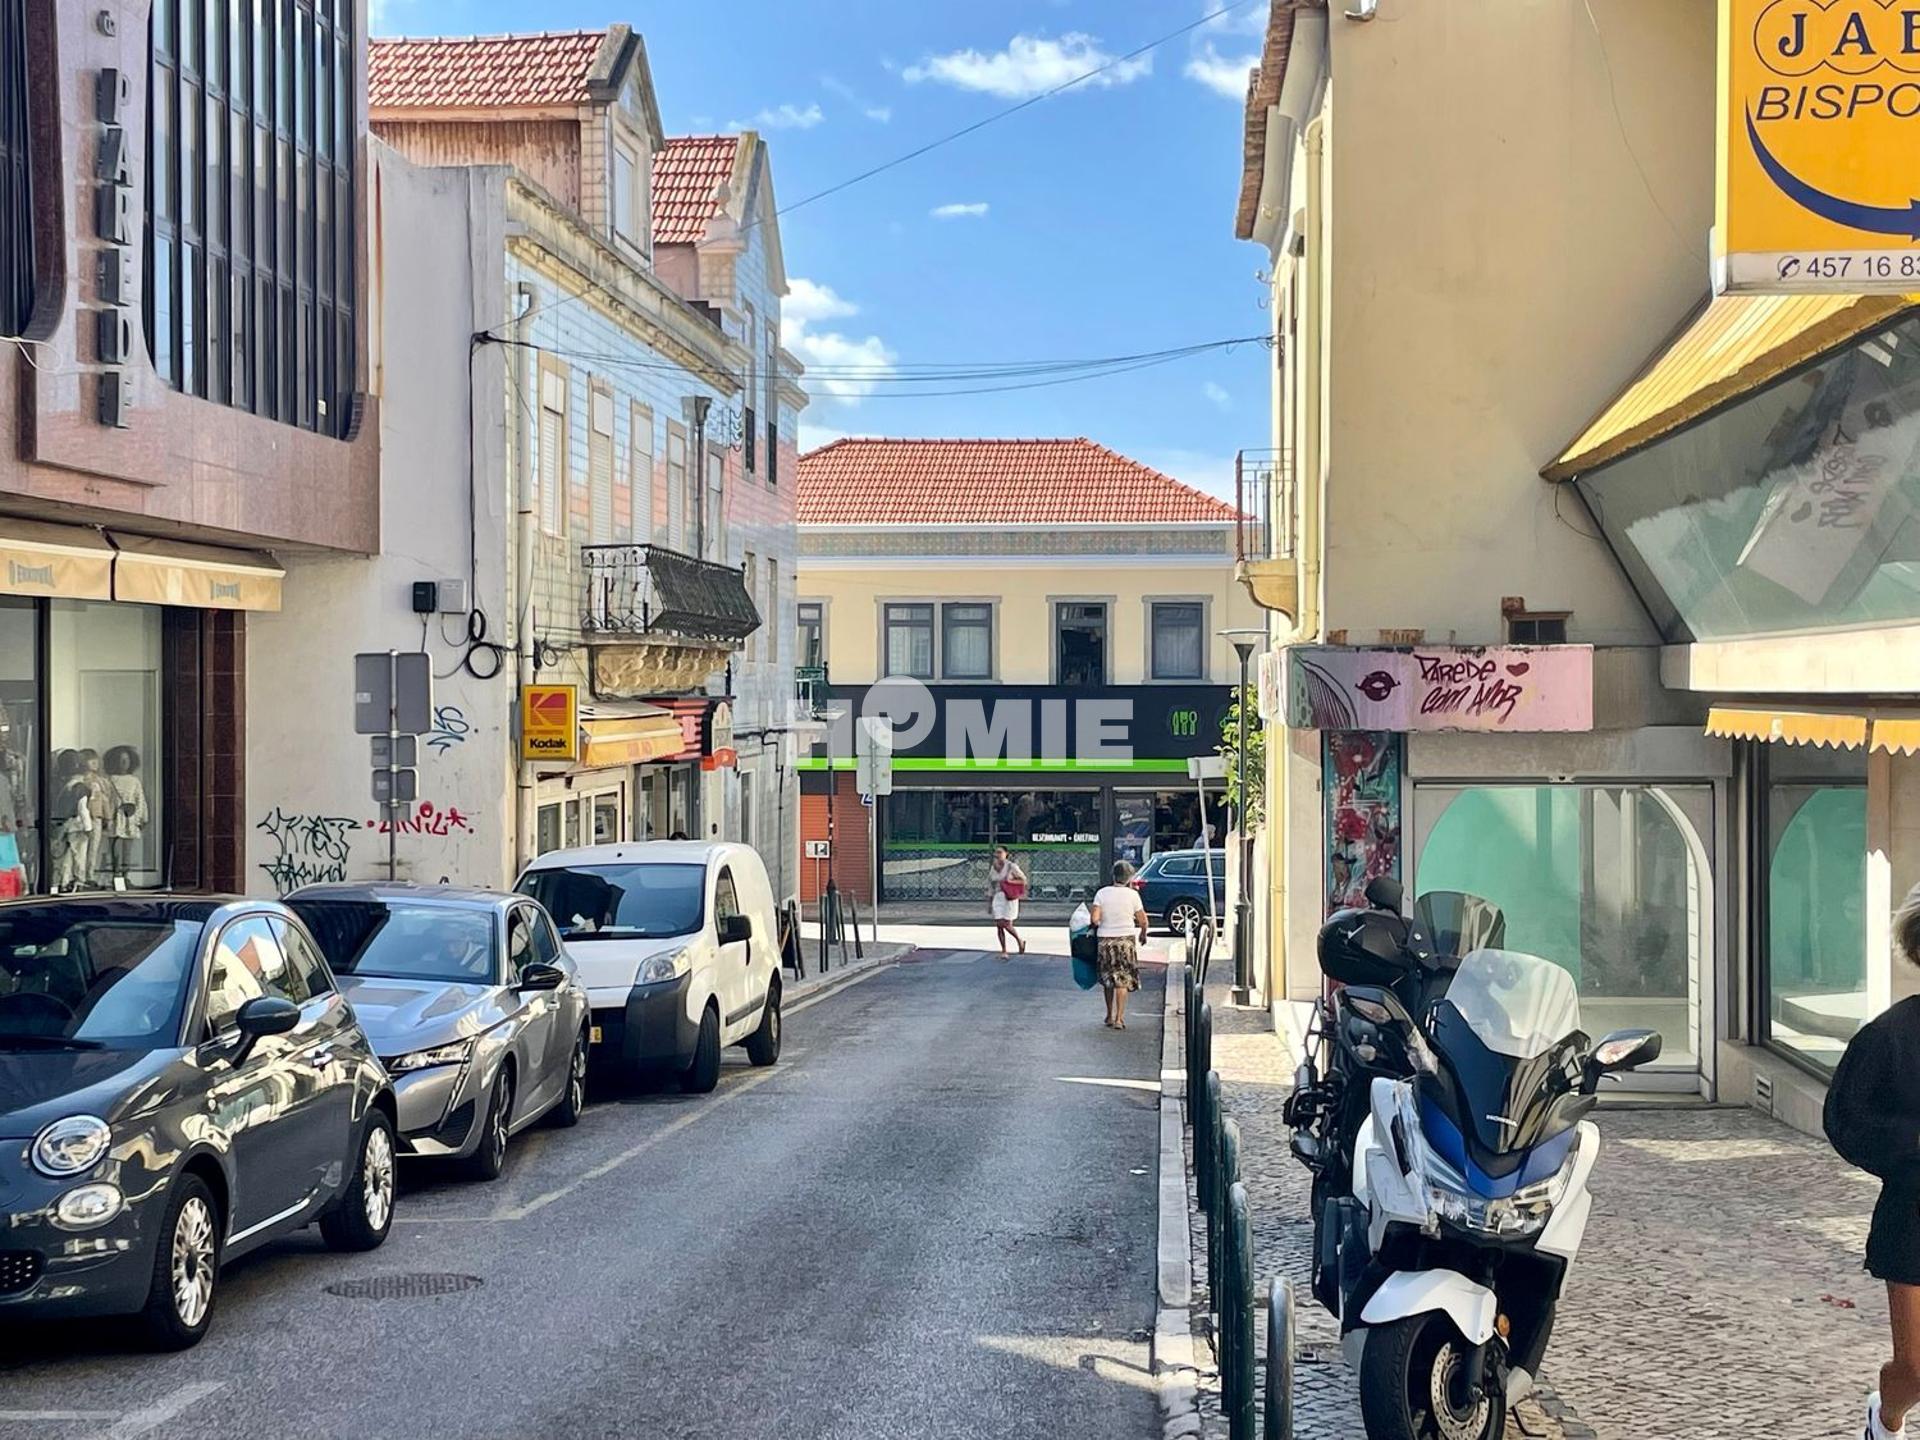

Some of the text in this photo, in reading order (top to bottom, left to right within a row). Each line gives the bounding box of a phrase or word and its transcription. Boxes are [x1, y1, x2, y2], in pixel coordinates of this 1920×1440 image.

[99, 68, 133, 430] PAREDE
[1806, 257, 1852, 278] 457
[1865, 256, 1891, 277] 16
[530, 738, 567, 749] Kodak
